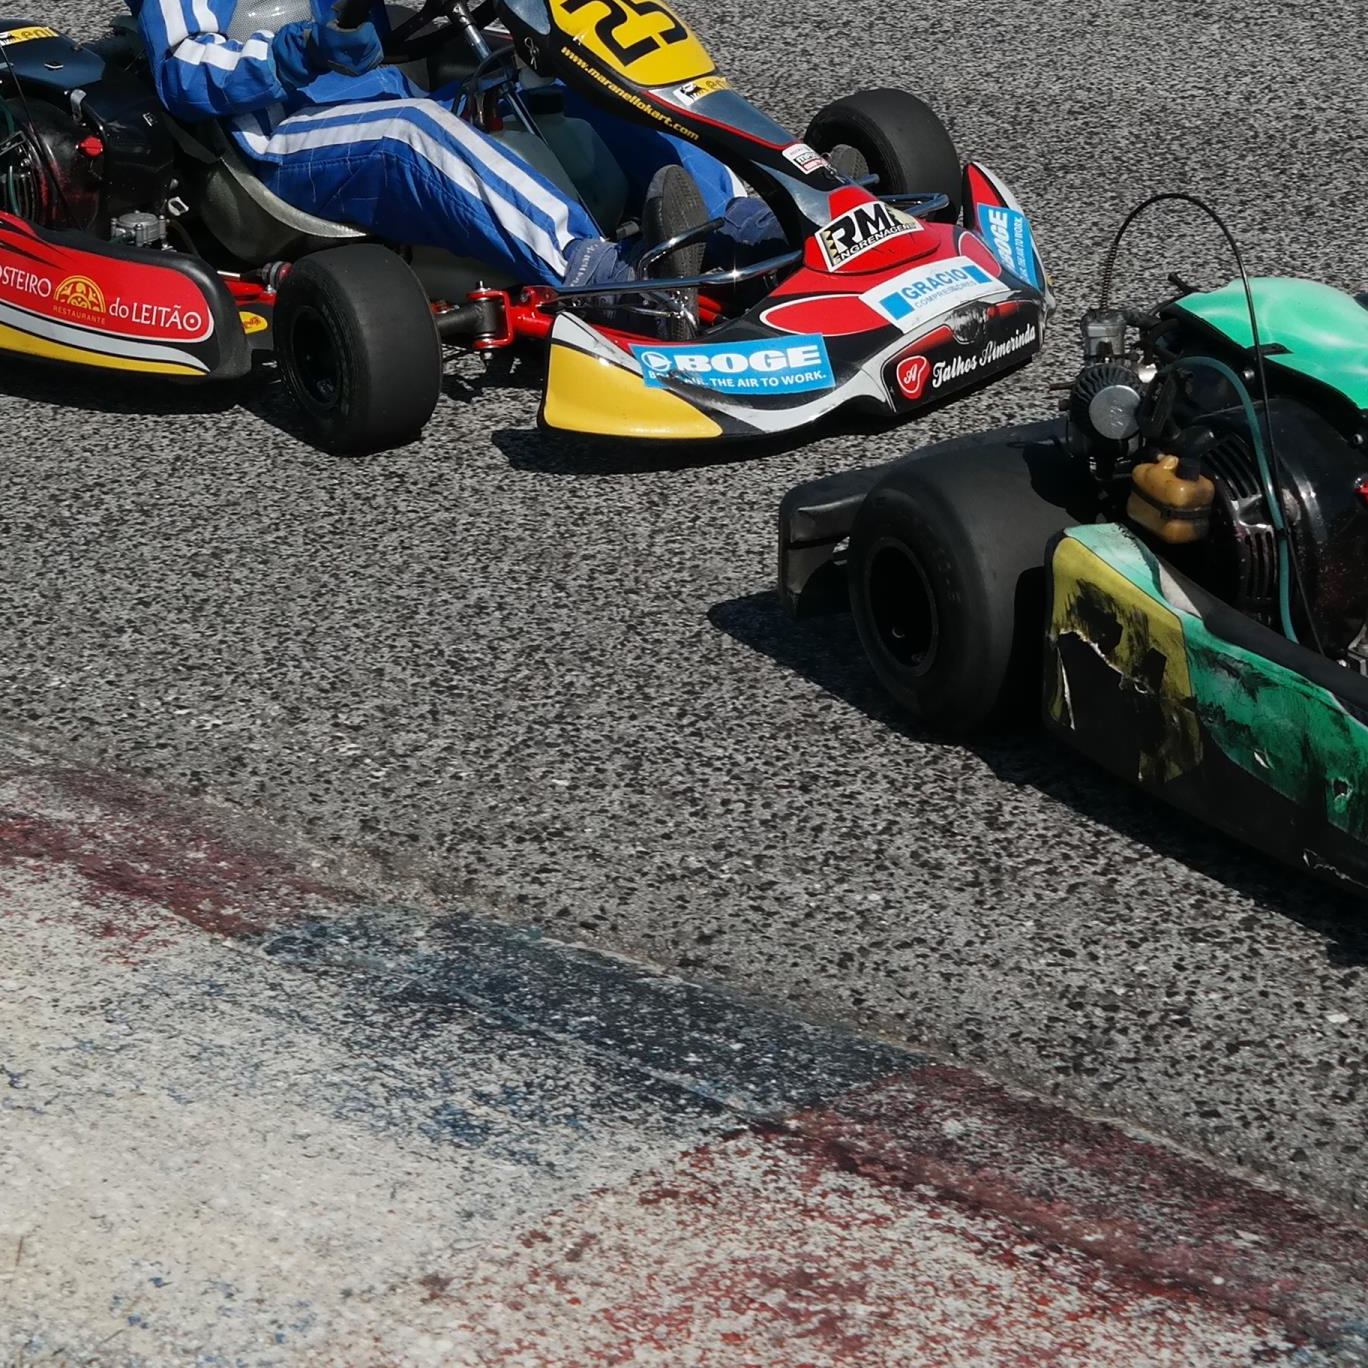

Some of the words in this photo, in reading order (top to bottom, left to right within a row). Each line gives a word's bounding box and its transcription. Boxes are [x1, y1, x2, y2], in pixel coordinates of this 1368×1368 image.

[561, 46, 700, 142] www.maranellokart.com
[902, 268, 969, 300] GRACIO
[53, 306, 106, 326] RESTAURANTE
[109, 298, 130, 318] do
[132, 305, 202, 332] LEITÃO
[675, 344, 823, 374] BOGE
[932, 355, 978, 388] Talhos
[711, 377, 733, 388] THE
[737, 377, 759, 389] AIR
[762, 376, 778, 387] TO
[781, 369, 828, 385] WORK.
